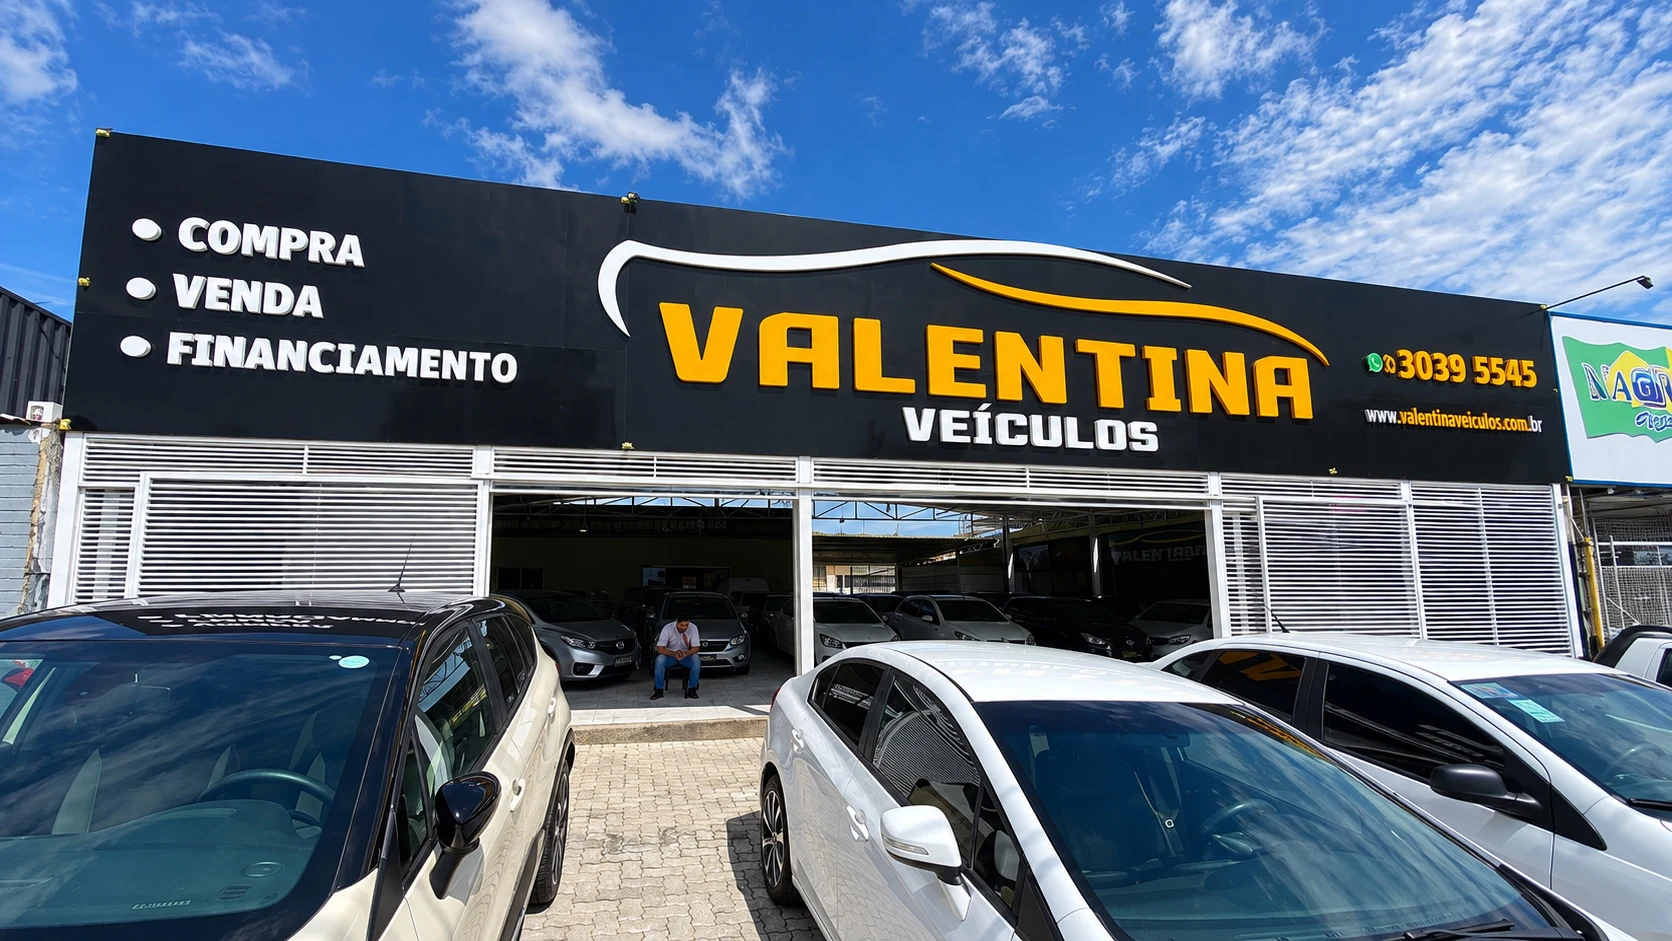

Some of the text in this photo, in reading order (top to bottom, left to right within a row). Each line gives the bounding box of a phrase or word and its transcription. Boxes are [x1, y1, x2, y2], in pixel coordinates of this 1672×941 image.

[177, 216, 365, 268] COMPRA
[173, 274, 323, 318] VENDA
[167, 332, 518, 384] FINANCIAMENTO
[659, 302, 1313, 420] VALENTINA
[1396, 349, 1538, 388] 3039 5545
[903, 403, 1159, 453] VEÍCULOS
[1364, 407, 1543, 433] www.valentinaveiculos.com.br
